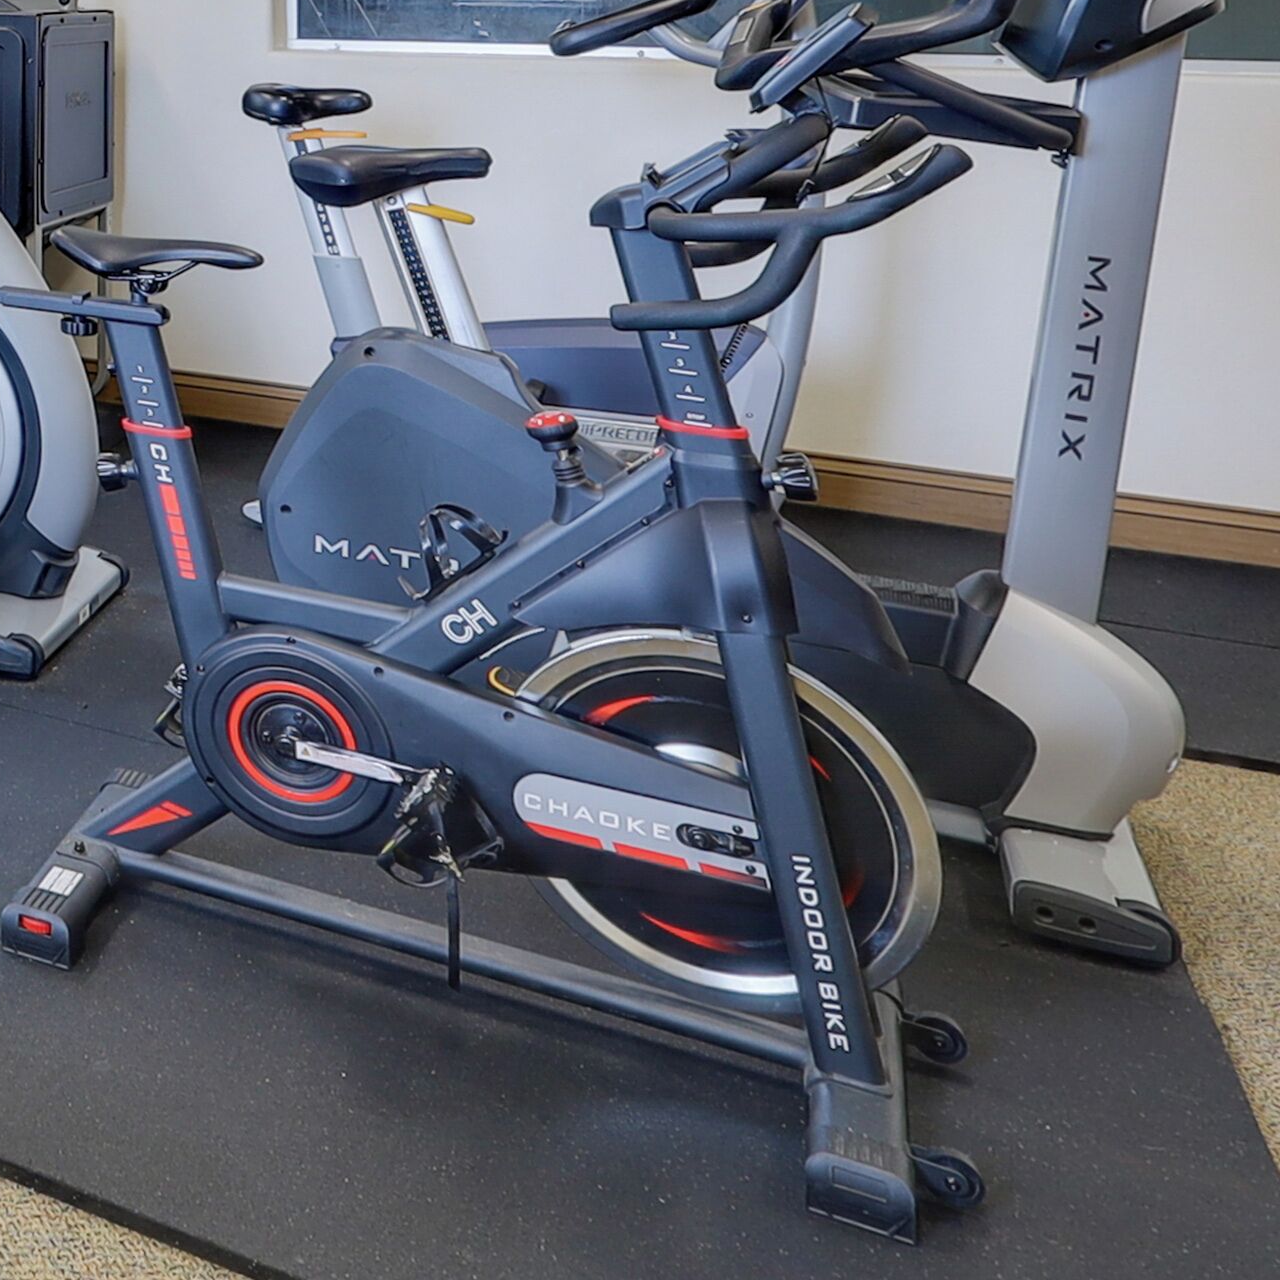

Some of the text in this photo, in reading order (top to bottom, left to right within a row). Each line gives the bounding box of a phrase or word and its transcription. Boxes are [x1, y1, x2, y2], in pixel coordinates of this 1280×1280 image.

[1058, 255, 1111, 461] MATRIX
[150, 443, 174, 484] CH
[441, 598, 497, 644] CH
[523, 793, 672, 841] CHAOKE
[791, 854, 850, 1052] INDOOR BIKE
